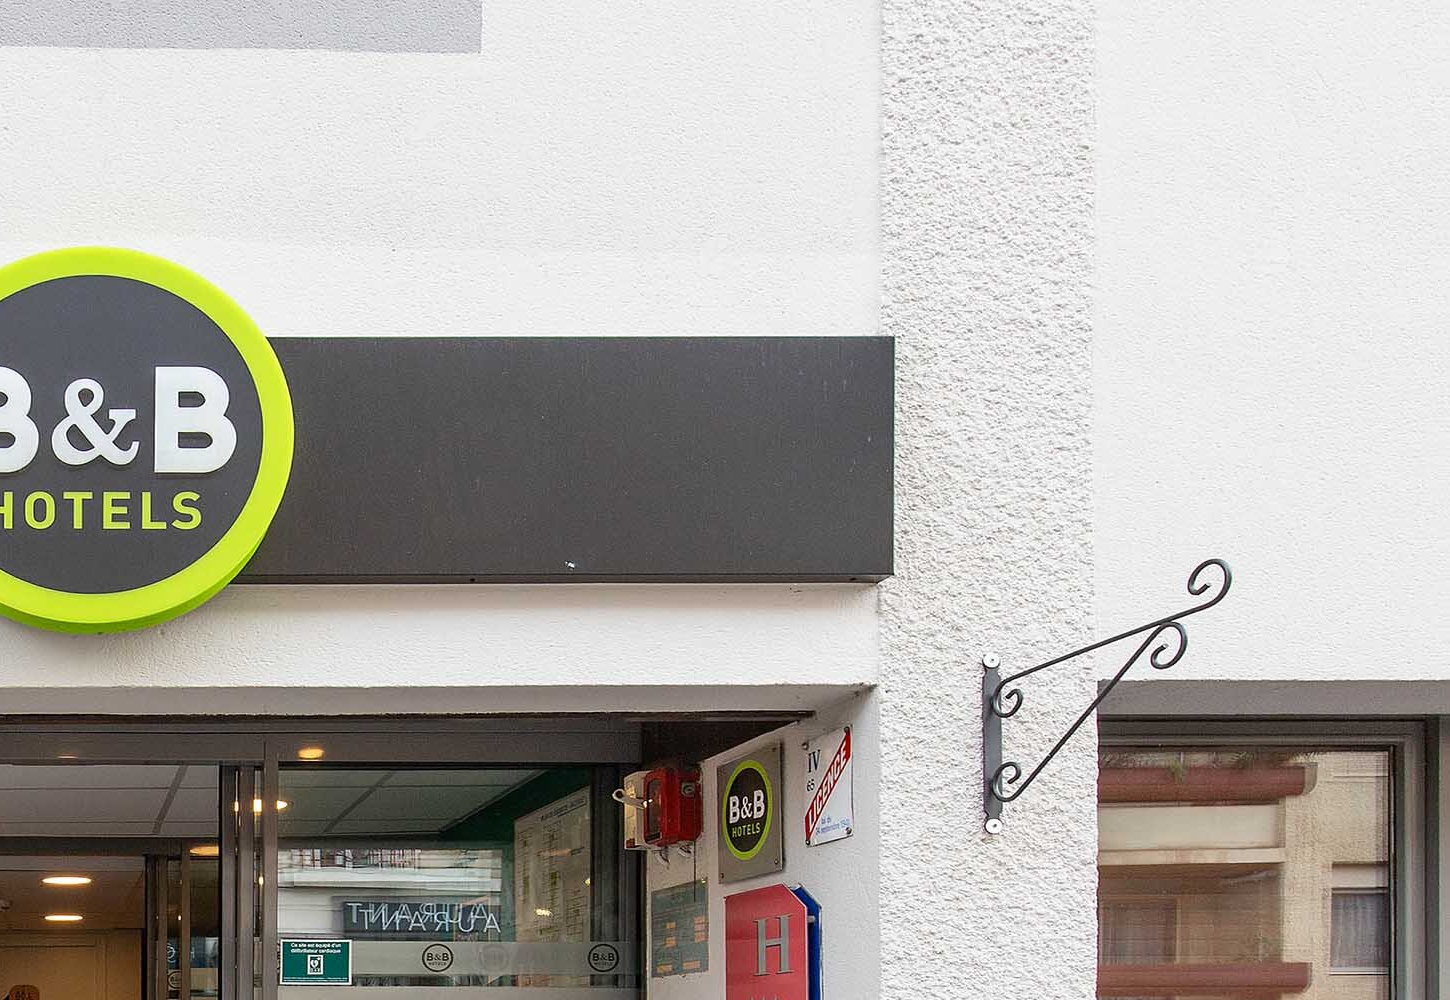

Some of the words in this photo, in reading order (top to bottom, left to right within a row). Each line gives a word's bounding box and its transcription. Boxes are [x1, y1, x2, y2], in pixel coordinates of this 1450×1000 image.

[807, 749, 821, 773] IV
[808, 740, 847, 833] LICENCE
[729, 789, 765, 824] B&B
[732, 824, 761, 838] HOTELS
[426, 953, 449, 961] B&B
[593, 953, 615, 961] B&B
[753, 913, 794, 977] H
